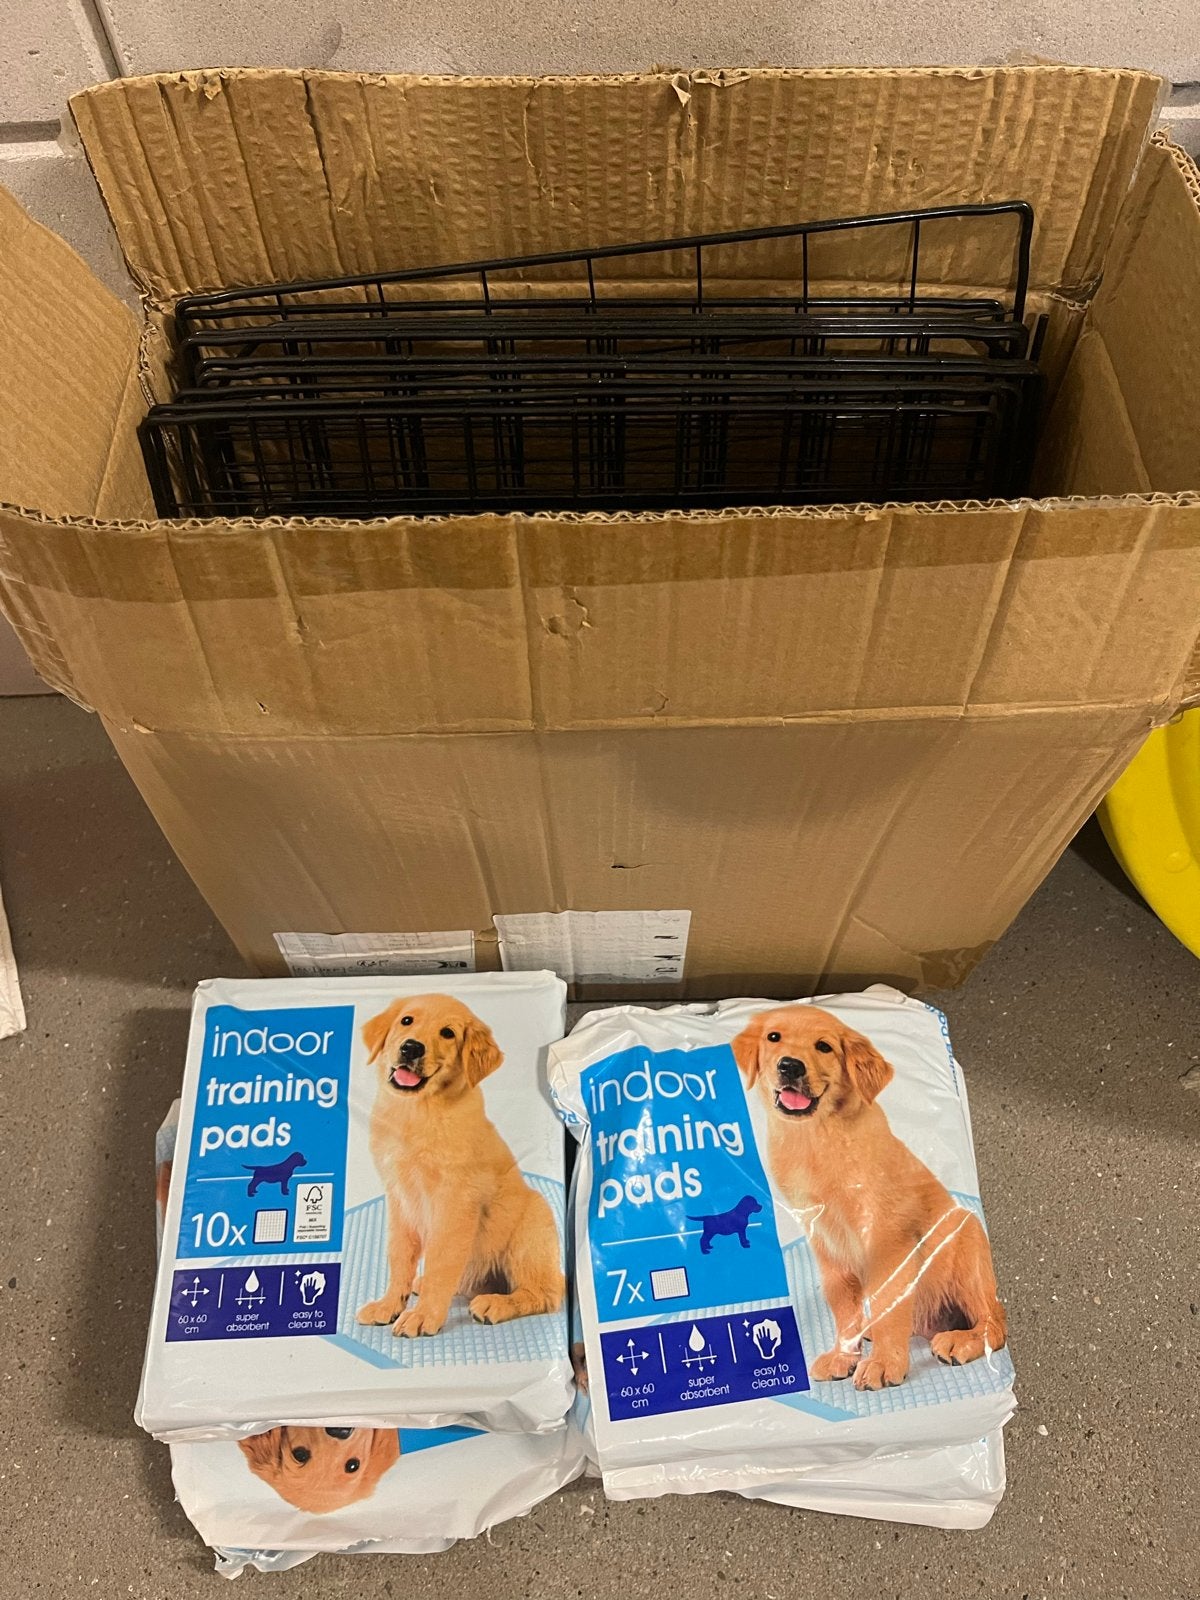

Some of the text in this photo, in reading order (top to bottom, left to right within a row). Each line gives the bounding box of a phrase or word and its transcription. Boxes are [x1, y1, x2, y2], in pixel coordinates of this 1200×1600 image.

[212, 1025, 334, 1057] indoor
[206, 1072, 339, 1108] training
[589, 1060, 717, 1115] indoor
[200, 1117, 291, 1157] pads
[597, 1113, 744, 1165] training
[598, 1162, 702, 1218] pads
[191, 1212, 248, 1247] 10x
[606, 1269, 645, 1307] 7x
[178, 1316, 189, 1324] 60
[196, 1314, 208, 1323] 60
[235, 1314, 259, 1323] super
[293, 1309, 324, 1320] easy to
[184, 1326, 200, 1334] cm
[226, 1322, 269, 1332] absorbent
[287, 1318, 327, 1329] clean up
[753, 1362, 789, 1378] easy to
[688, 1375, 715, 1388] super
[751, 1374, 796, 1390] clean up
[620, 1382, 655, 1398] 60 x 60
[680, 1384, 730, 1401] absorbent
[631, 1399, 649, 1409] cm
